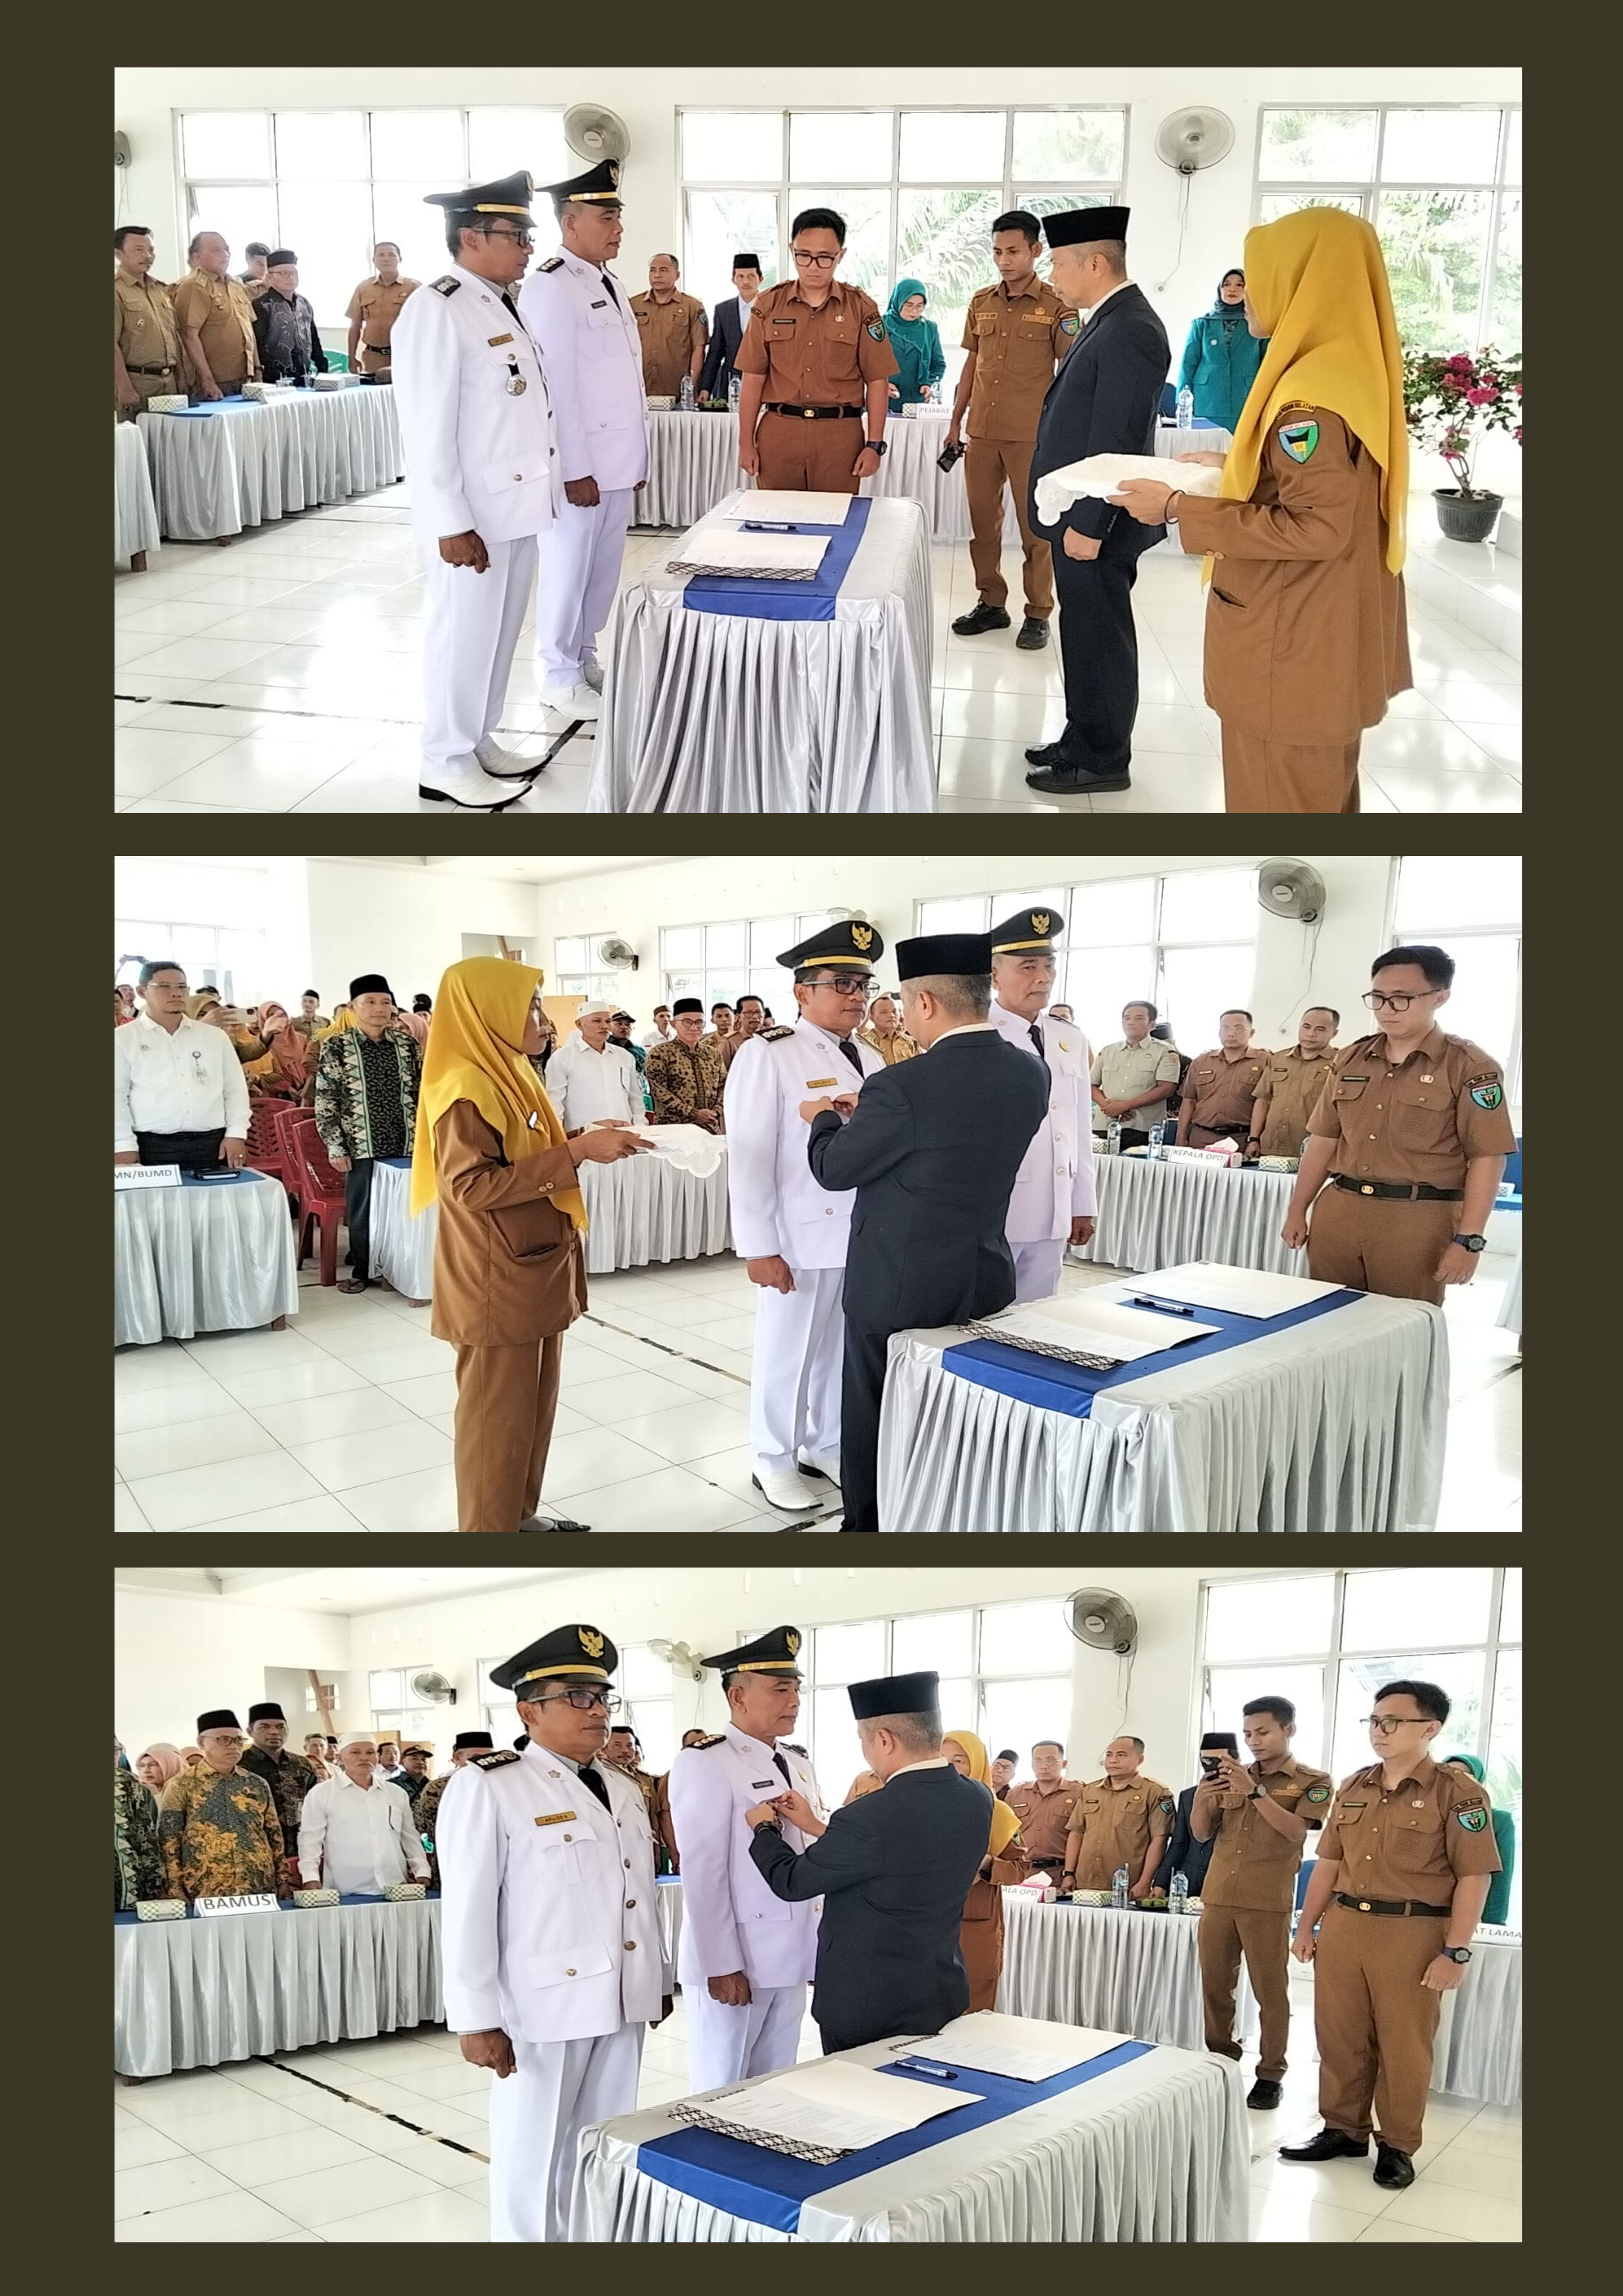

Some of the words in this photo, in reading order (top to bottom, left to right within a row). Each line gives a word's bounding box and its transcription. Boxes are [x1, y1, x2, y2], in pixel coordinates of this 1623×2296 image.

[1173, 1149, 1203, 1159] KEPALA
[203, 1894, 271, 1910] BAMUS
[1489, 1929, 1522, 1939] LAMA
